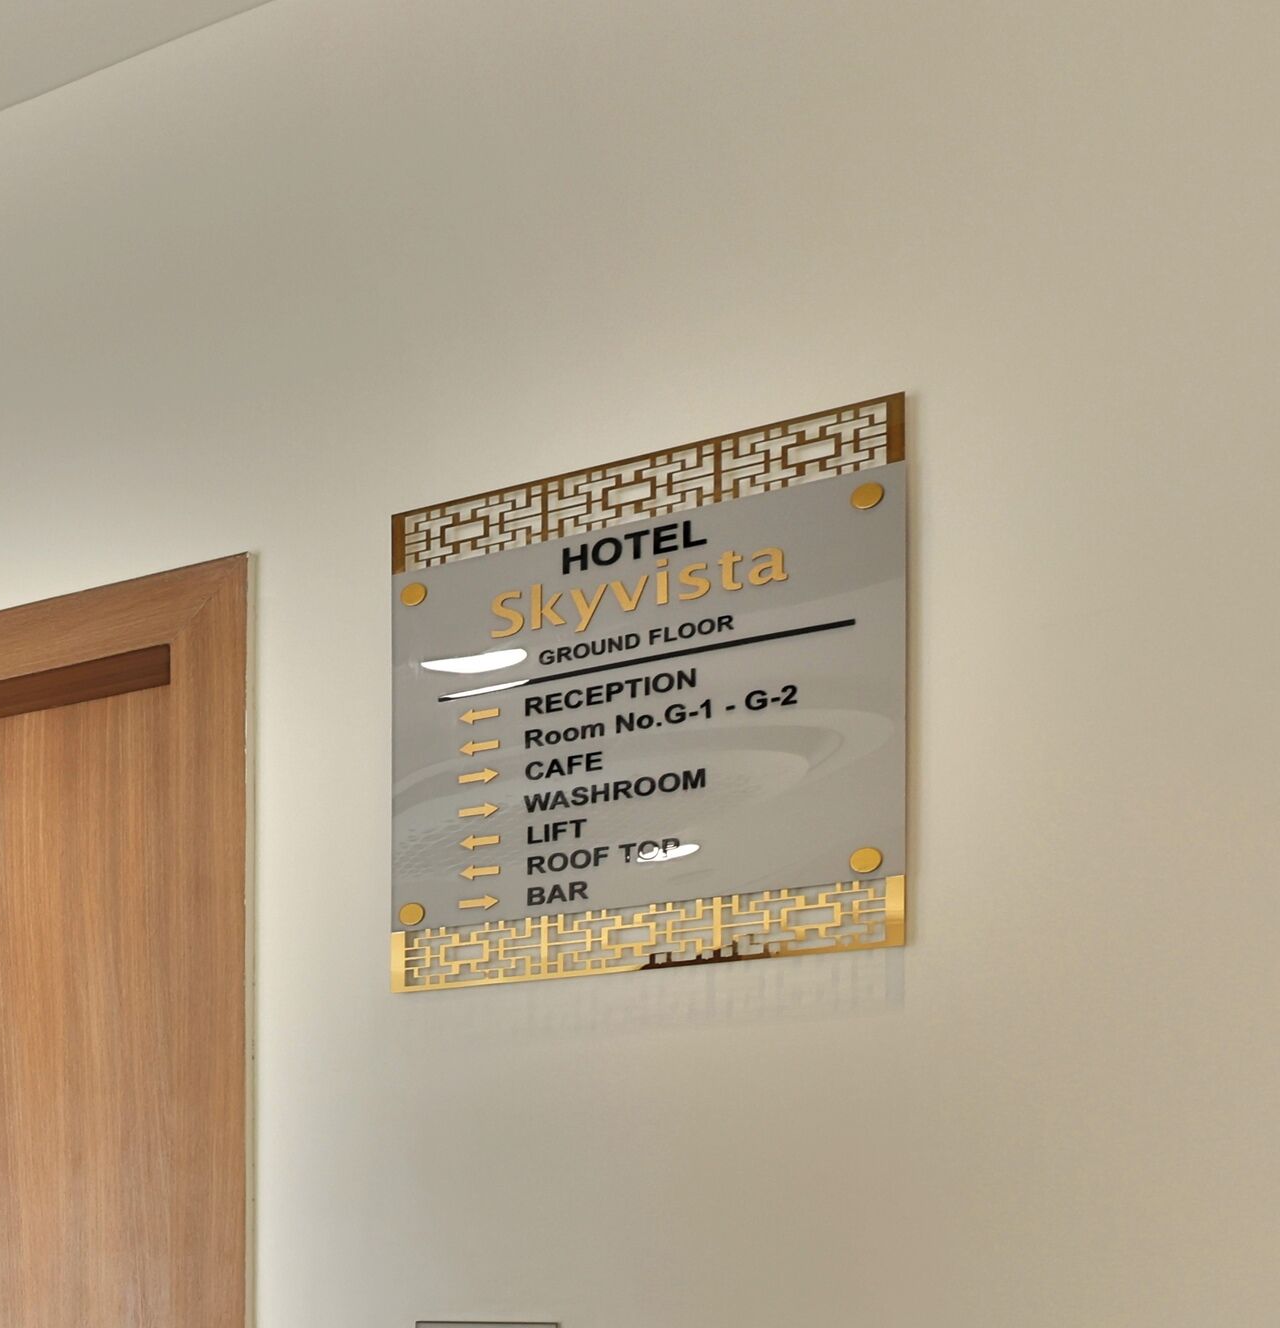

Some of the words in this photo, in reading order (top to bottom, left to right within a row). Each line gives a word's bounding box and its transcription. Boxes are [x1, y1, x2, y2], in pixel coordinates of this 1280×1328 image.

[561, 519, 707, 575] HOTEL
[490, 546, 789, 638] Skyvista
[538, 632, 641, 666] GROUND
[648, 614, 735, 646] FLOOR
[524, 667, 698, 717] RECEPTION
[524, 721, 605, 749] Room
[615, 698, 713, 735] No.G-1
[744, 684, 799, 712] G-2
[524, 750, 604, 781] CAFE
[523, 767, 707, 814] WASHROOM
[527, 818, 588, 845] LIFT
[527, 845, 610, 876] ROOF
[618, 836, 681, 864] TOP
[526, 880, 589, 906] BAR
